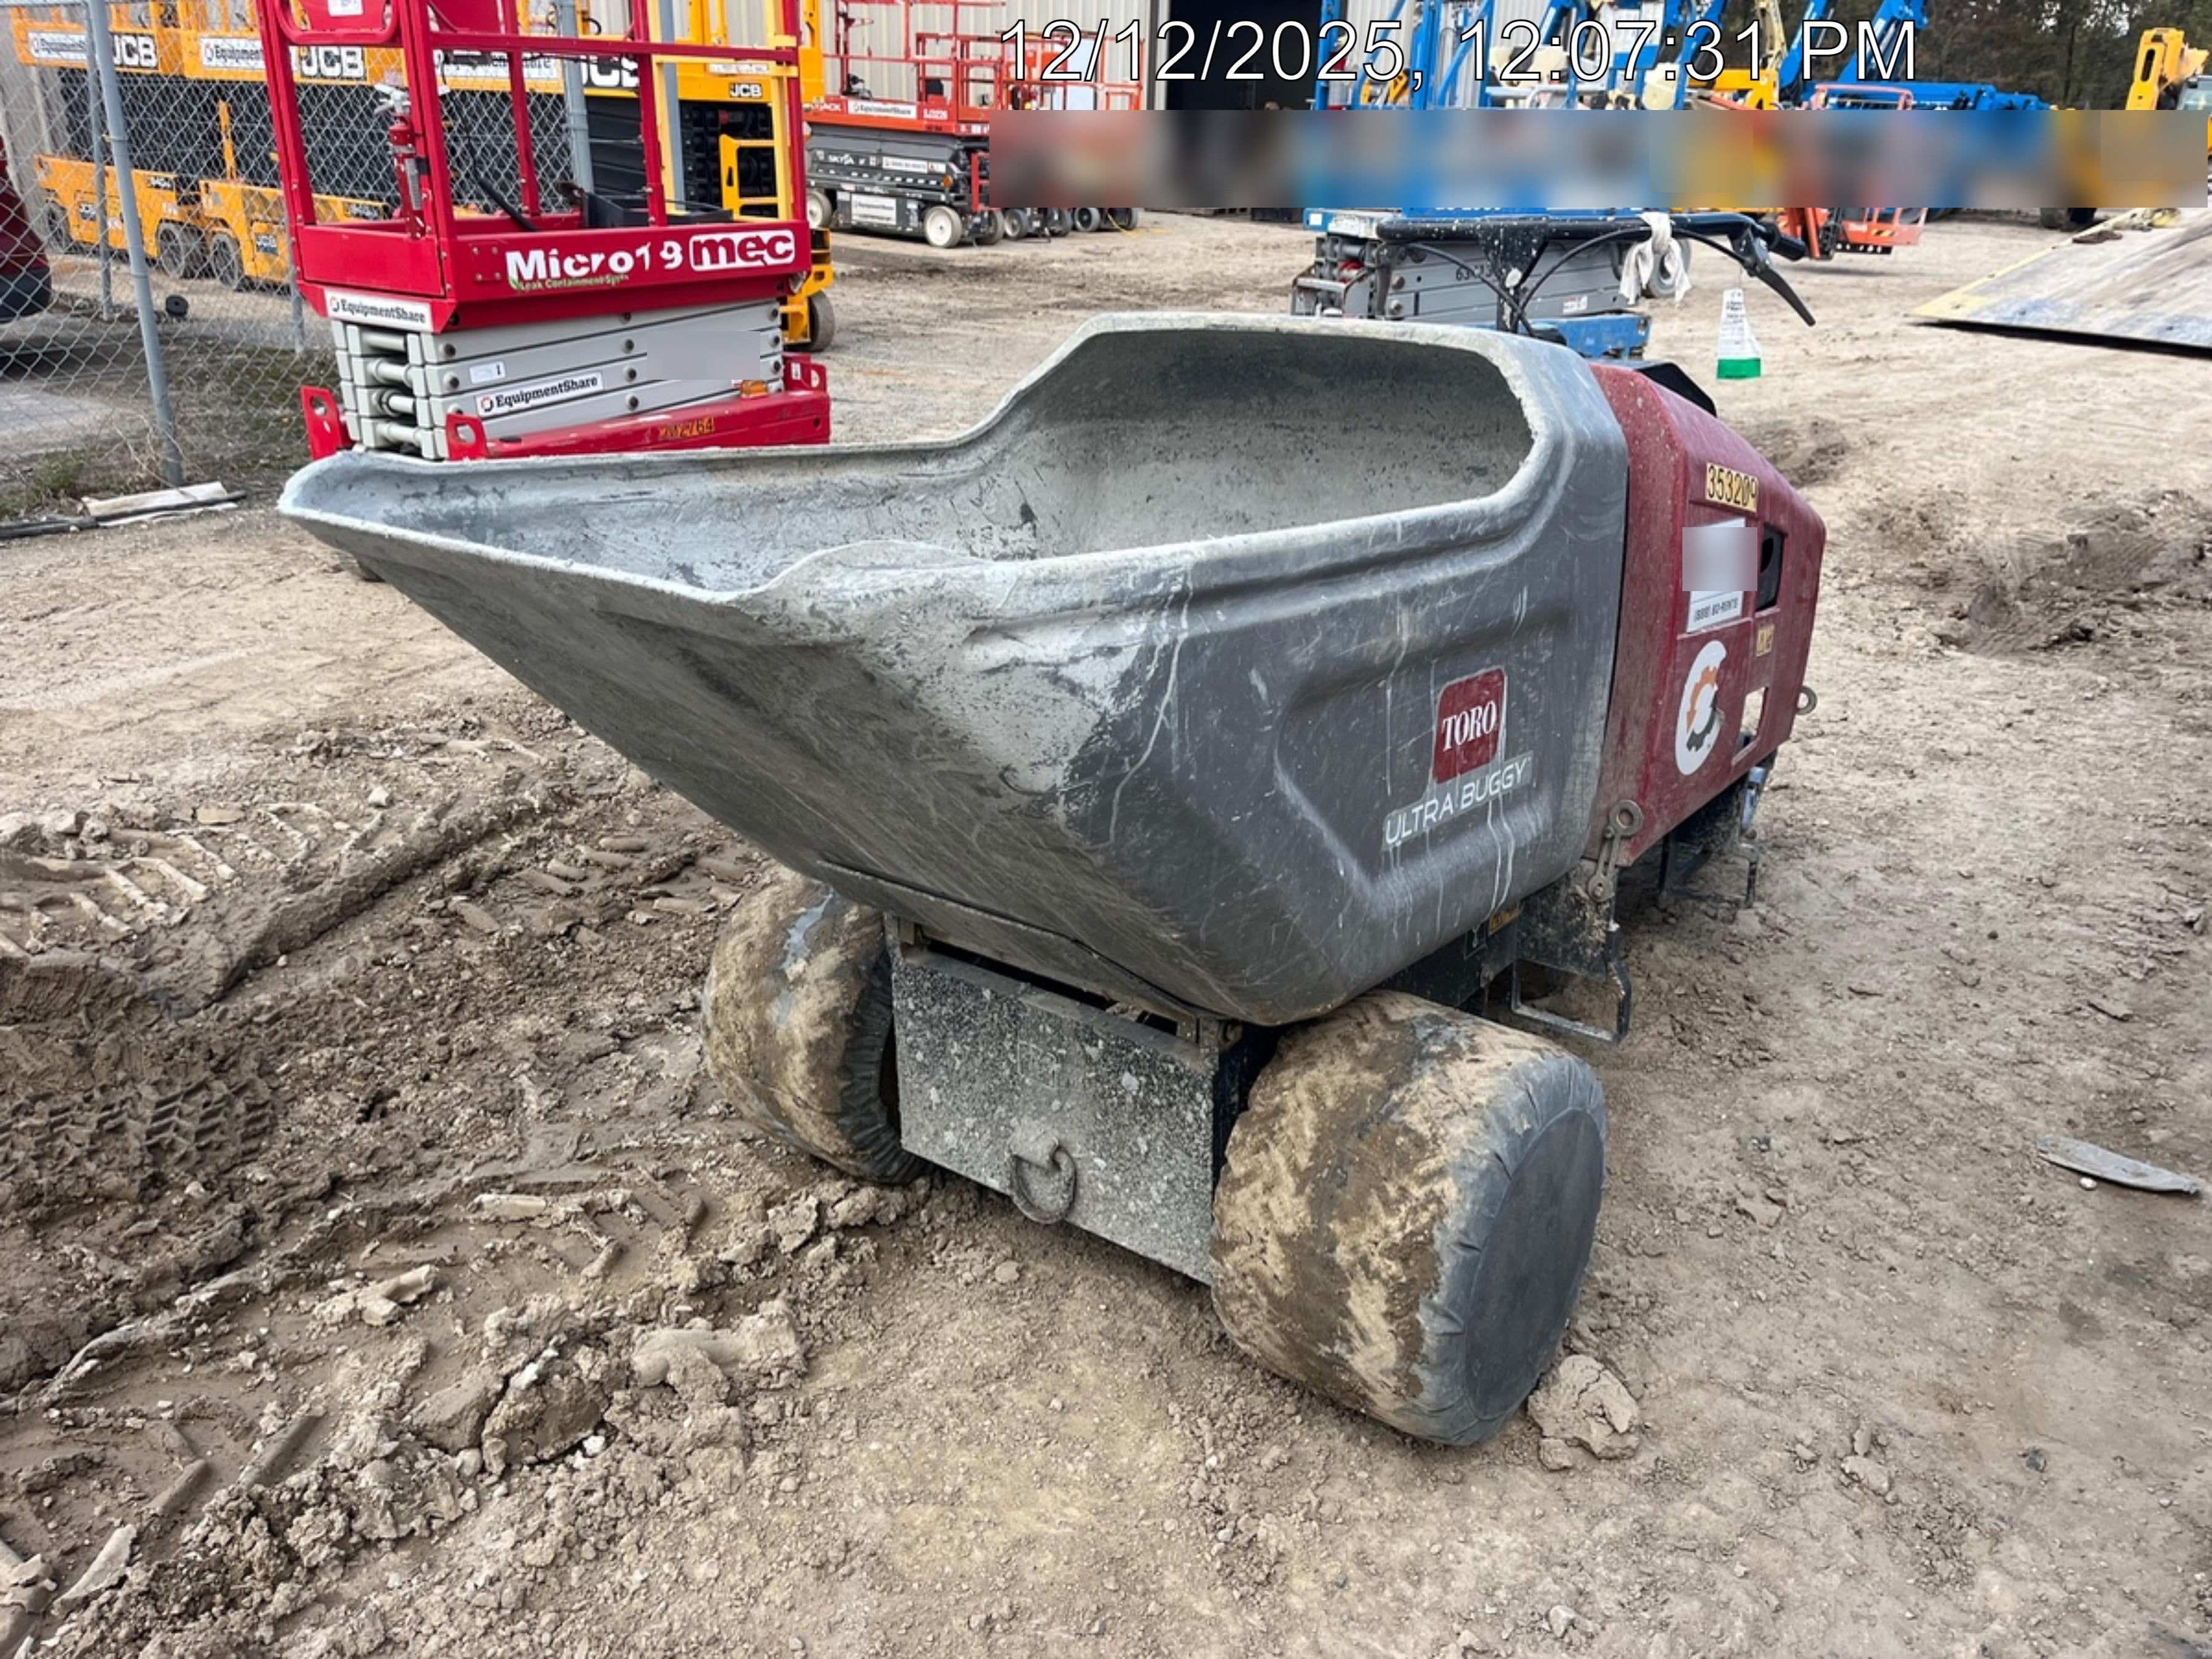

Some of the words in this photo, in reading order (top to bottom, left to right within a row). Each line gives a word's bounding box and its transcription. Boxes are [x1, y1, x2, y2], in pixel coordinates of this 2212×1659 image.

[302, 45, 364, 77] JCB
[729, 83, 763, 98] JCB
[692, 234, 794, 268] mec
[340, 298, 426, 324] EquipmentShare
[495, 375, 598, 408] EquipmentShare
[1442, 699, 1497, 752] TORO
[1385, 792, 1454, 845] ULTRA
[1459, 758, 1529, 811] BUGGY
